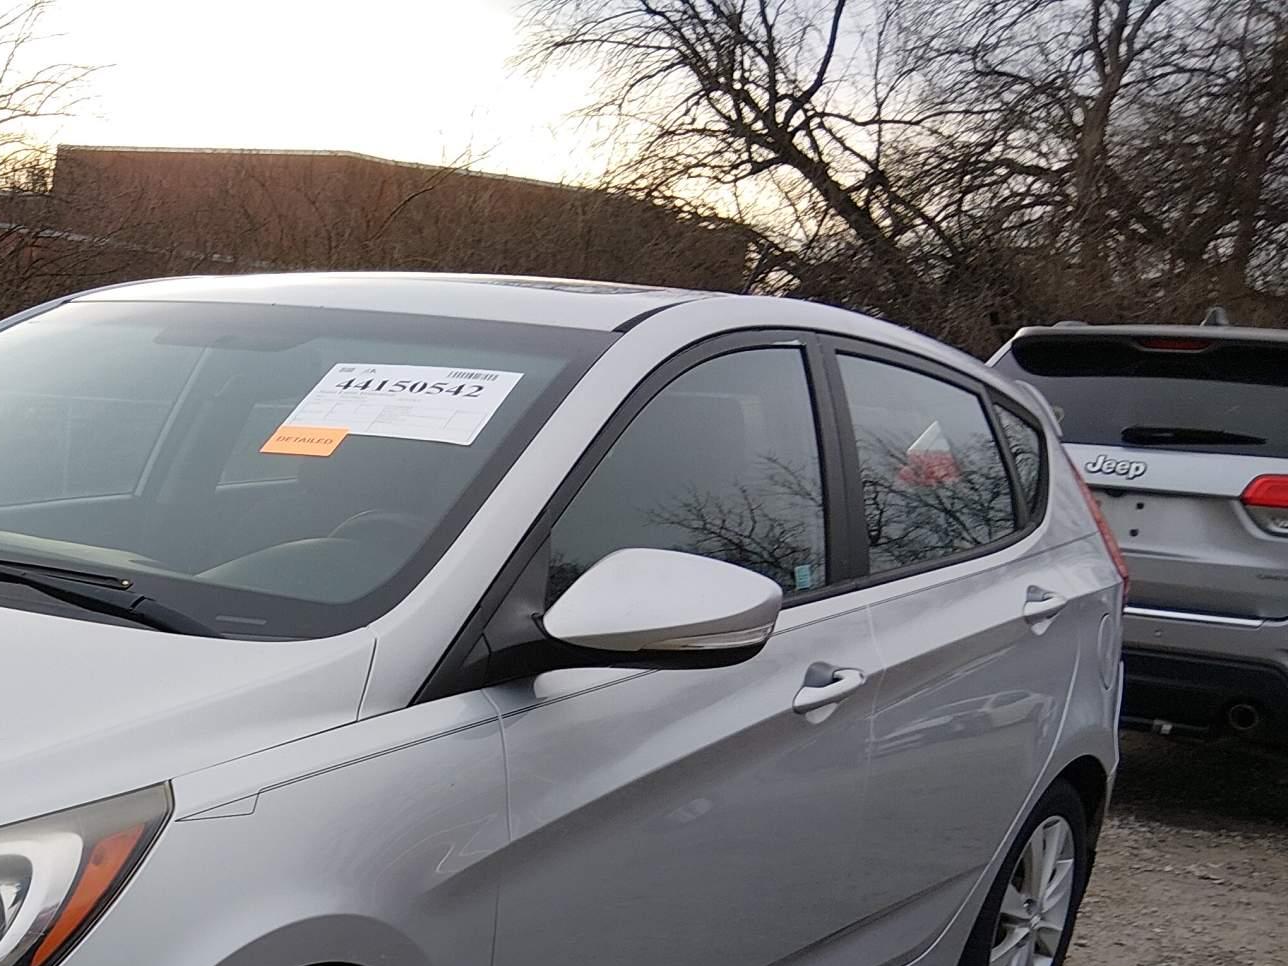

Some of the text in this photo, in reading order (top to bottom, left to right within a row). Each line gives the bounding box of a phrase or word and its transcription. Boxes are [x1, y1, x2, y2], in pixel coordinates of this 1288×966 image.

[336, 378, 485, 398] 44150542
[275, 435, 333, 446] DETAILED
[1085, 454, 1147, 480] Jeep
